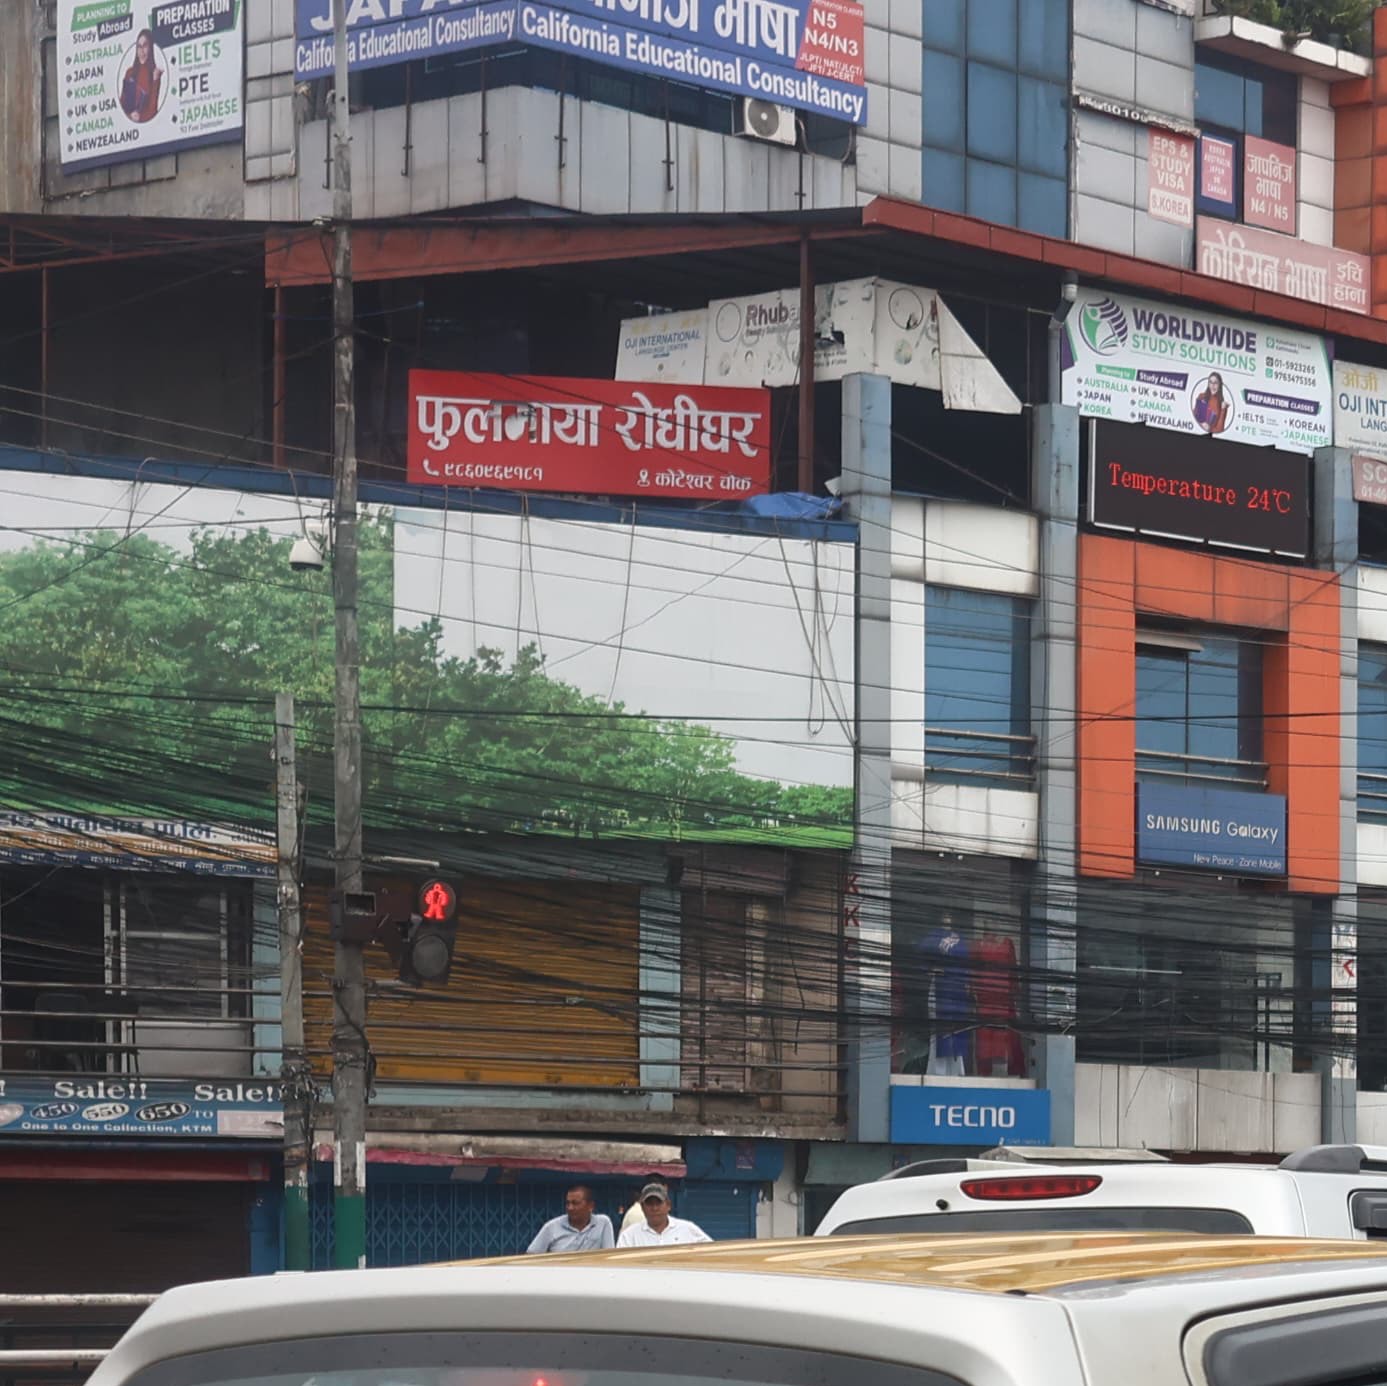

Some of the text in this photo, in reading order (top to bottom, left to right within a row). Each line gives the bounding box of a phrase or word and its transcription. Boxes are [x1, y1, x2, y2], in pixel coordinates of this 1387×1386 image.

[76, 3, 127, 22] PLANNING TO
[157, 0, 229, 26] PREPARATION
[813, 8, 838, 29] N5
[72, 18, 130, 44] Study Abroad
[172, 18, 215, 38] CLASSES
[359, 17, 433, 59] Educational
[435, 8, 516, 45] Consultancy
[714, 0, 799, 58] भाषा
[178, 39, 221, 65] IELTS
[805, 28, 858, 57] N4/N3
[73, 43, 124, 65] AUSTRALIA
[522, 6, 620, 57] California
[626, 33, 741, 85] Educational
[747, 63, 864, 119] Consultancy
[73, 65, 104, 82] JAPAN
[75, 83, 105, 98] KOREA
[179, 73, 209, 97] PTE
[75, 98, 117, 116] UK USA
[180, 98, 238, 124] JAPANESE
[75, 117, 114, 134] CANADA
[75, 129, 140, 152] NEWZEALAND
[1153, 136, 1188, 157] EPS &
[1151, 154, 1191, 175] STUDY
[1157, 171, 1185, 192] VISA
[1251, 199, 1265, 215] N4
[1274, 205, 1289, 221] N5
[638, 330, 701, 349] INTERNATIONAL
[1132, 307, 1257, 353] WORLDWIDE
[1132, 335, 1177, 356] STUDY
[1179, 343, 1256, 372] SOLUTIONS
[1084, 378, 1176, 401] AUSTRALIA UK USA
[1140, 372, 1184, 387] Study Abroad
[1084, 391, 1172, 413] JAPAN CANADA
[1247, 392, 1314, 412] PREPARATION CLASSES
[1338, 392, 1361, 412] OJI
[1084, 403, 1194, 431] KOREA NEWZEALAND
[1242, 412, 1326, 433] IELTS KOREAN
[1241, 425, 1256, 435] PTE
[1283, 430, 1328, 446] JAPANESE
[1109, 463, 1237, 505] Temperature
[1146, 814, 1278, 845] SAMSUNG Galaxy
[1194, 853, 1210, 864] New
[1212, 855, 1234, 866] Peace
[54, 1081, 148, 1100] Sale!!
[35, 1102, 214, 1122] 450 550 650 TO
[929, 1104, 1016, 1128] TECNO
[22, 1122, 213, 1134] One to One Collection, KTM
